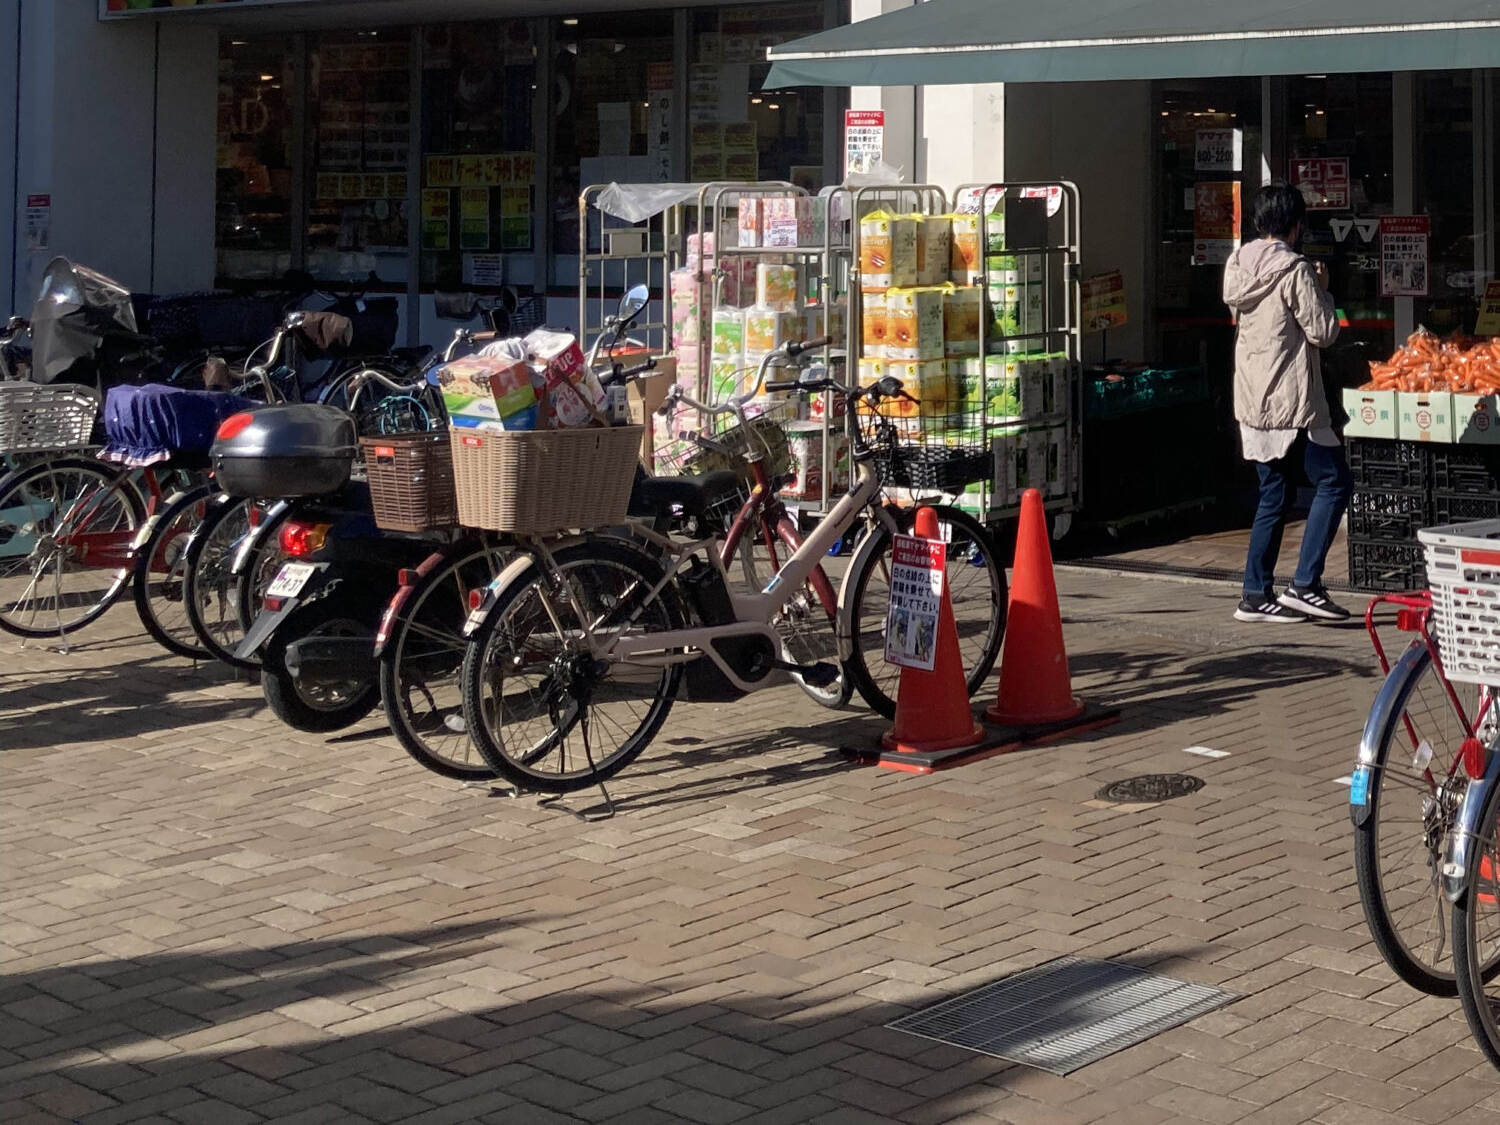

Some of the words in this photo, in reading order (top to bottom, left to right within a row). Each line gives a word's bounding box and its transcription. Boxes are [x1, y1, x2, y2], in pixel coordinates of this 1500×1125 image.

[1297, 161, 1347, 181] 出口
[893, 567, 940, 585] 白の点線の上に
